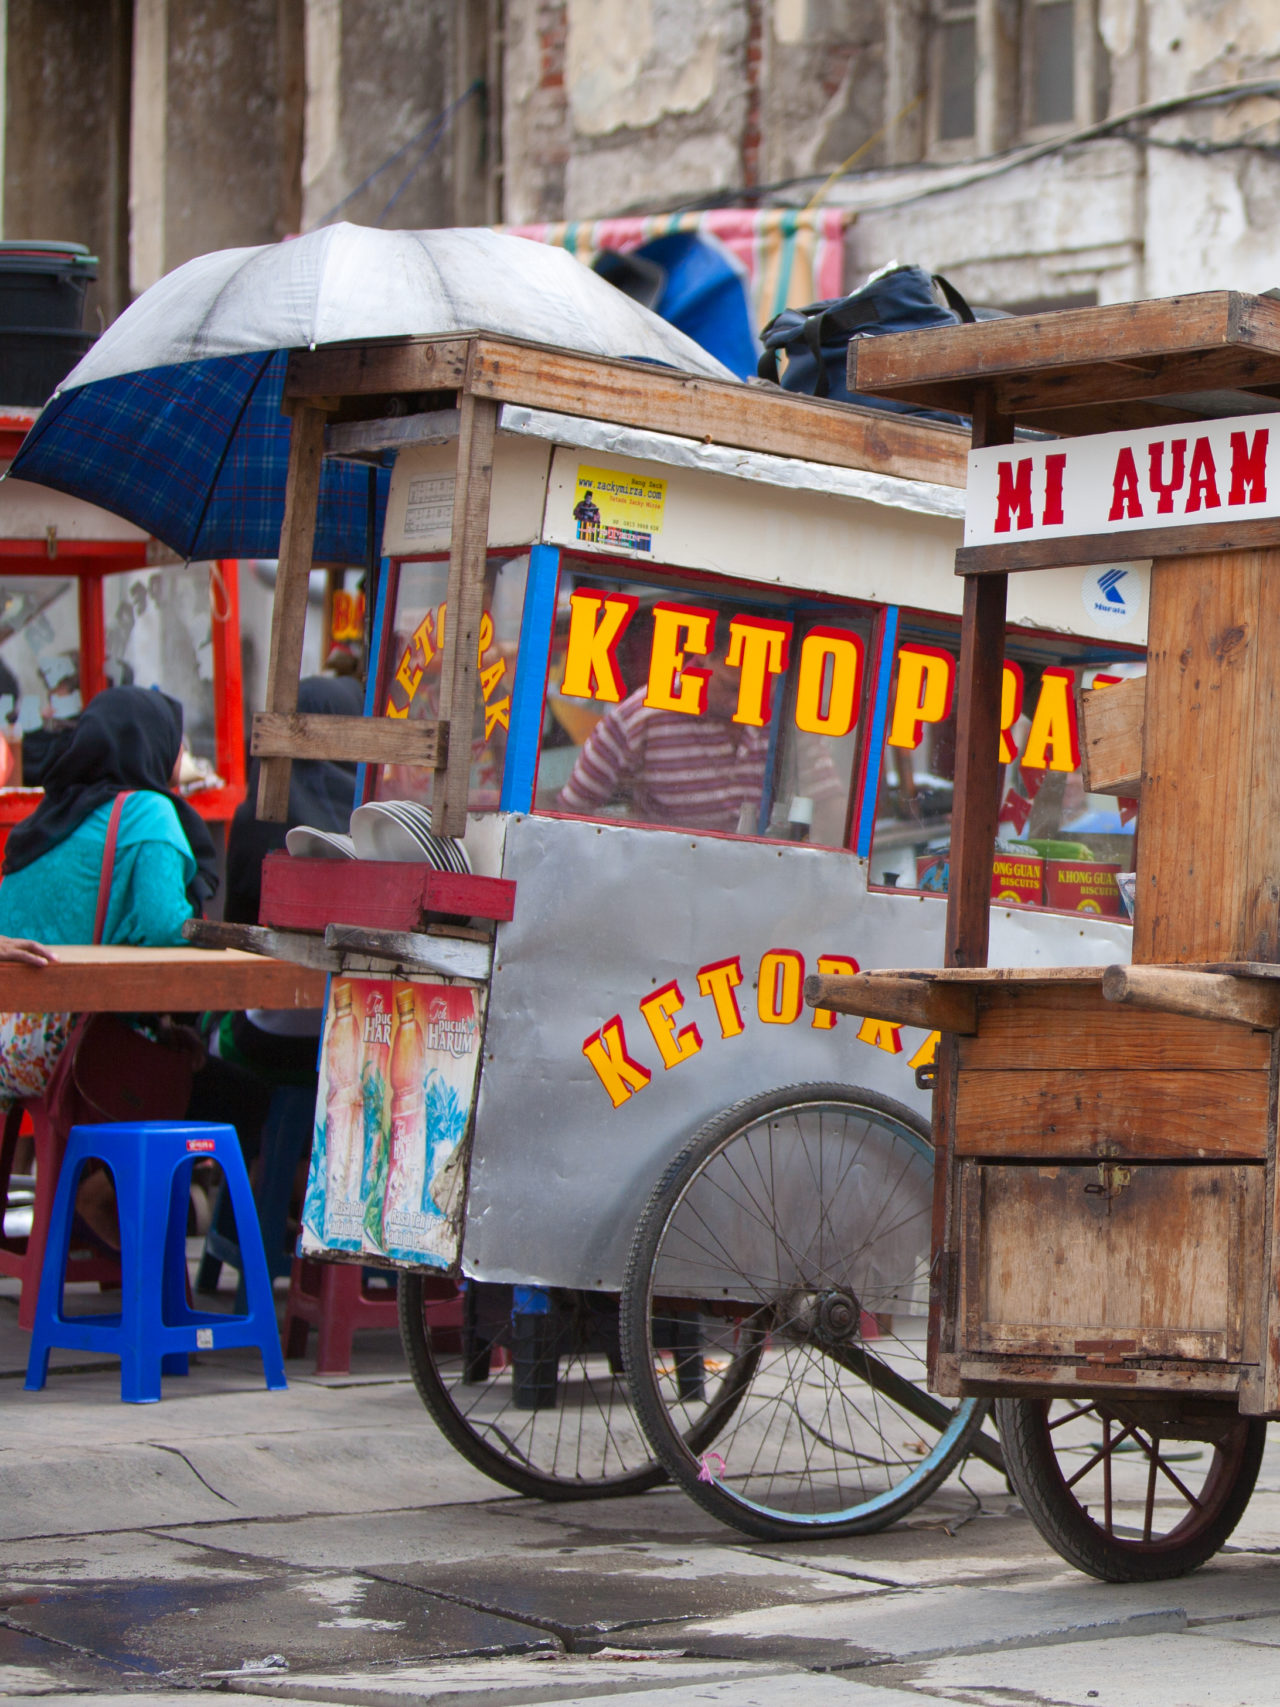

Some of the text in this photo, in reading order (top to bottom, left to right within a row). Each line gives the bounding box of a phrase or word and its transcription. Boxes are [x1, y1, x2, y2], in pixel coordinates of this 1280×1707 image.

[993, 429, 1270, 533] MI AYAM
[1014, 863, 1041, 878] GUAN
[1058, 870, 1092, 884] KHONG
[1000, 877, 1040, 889] BISCUITS
[439, 1017, 467, 1036] pucuk
[427, 1022, 474, 1059] HARUM
